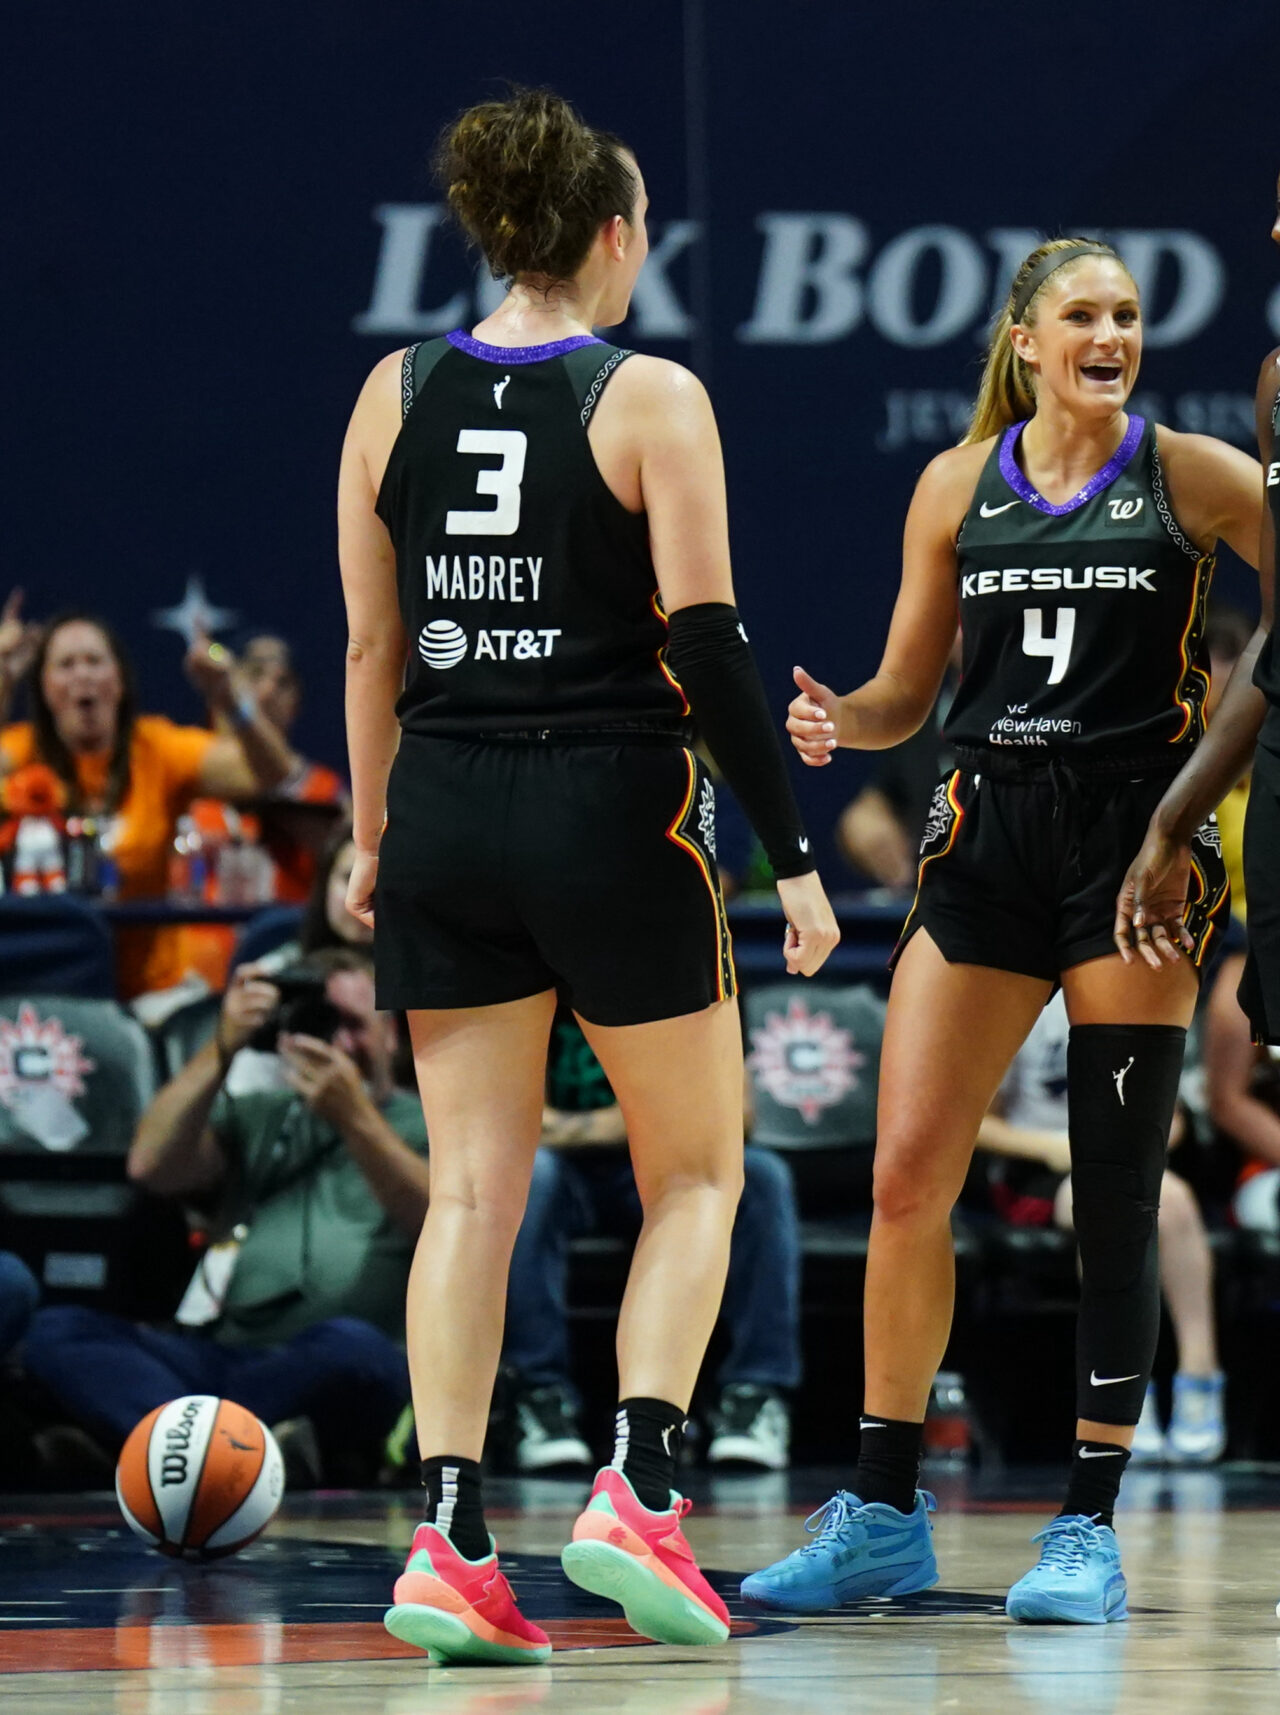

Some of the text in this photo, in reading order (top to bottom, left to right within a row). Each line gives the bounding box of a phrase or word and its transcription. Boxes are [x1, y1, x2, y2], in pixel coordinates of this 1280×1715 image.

[445, 429, 528, 536] 3
[425, 554, 543, 603] MABREY
[961, 566, 1158, 599] KEESUSK
[474, 628, 562, 661] AT&T
[1021, 607, 1076, 685] 4
[991, 716, 1082, 734] NewHaven
[161, 1401, 204, 1488] Wilson
